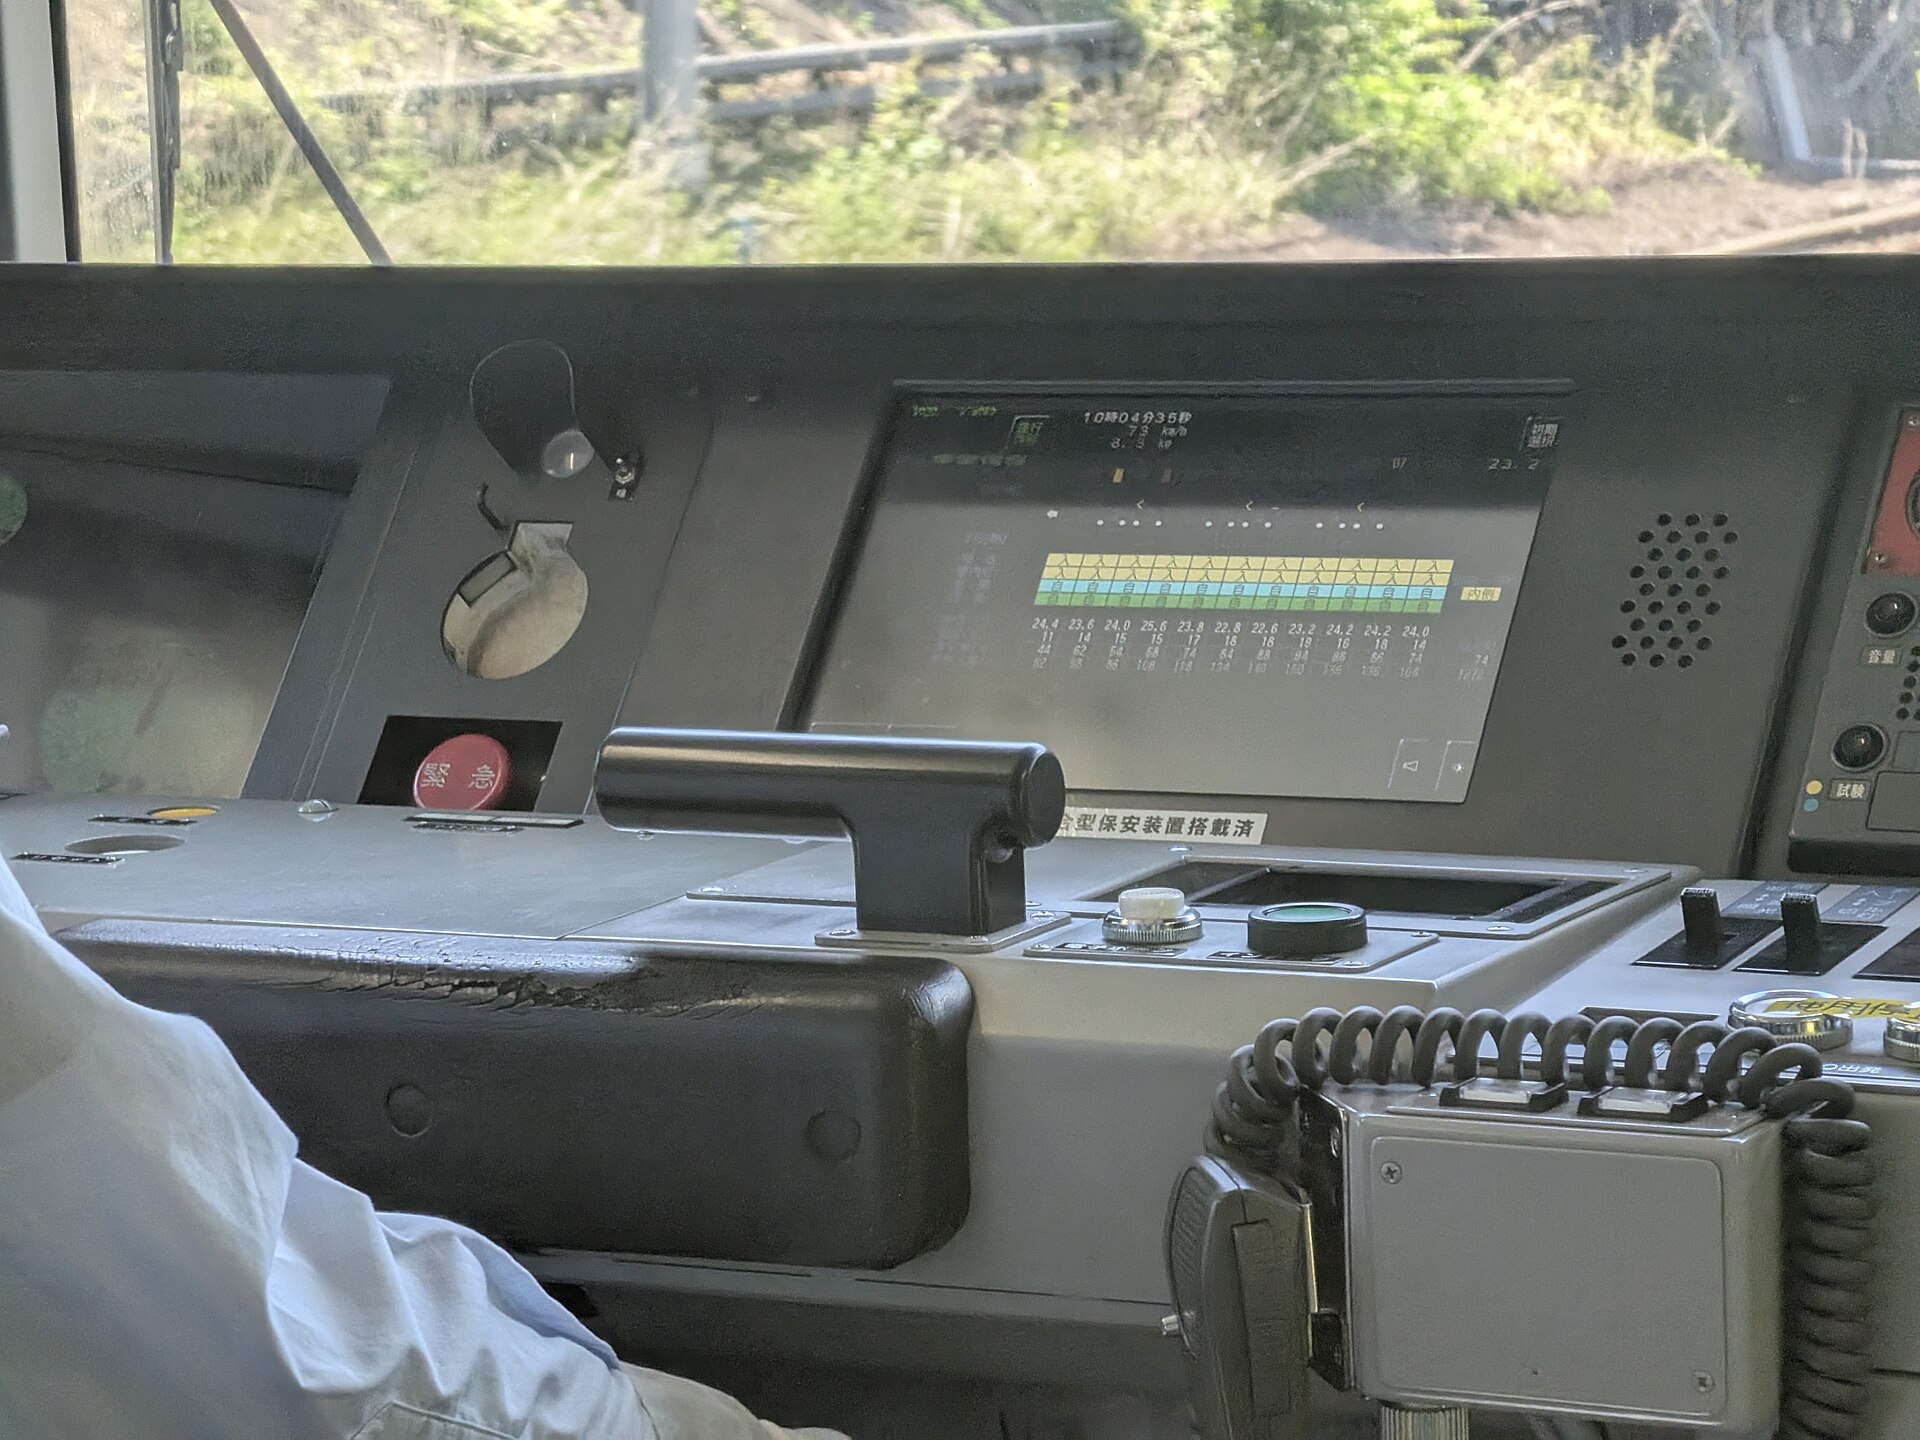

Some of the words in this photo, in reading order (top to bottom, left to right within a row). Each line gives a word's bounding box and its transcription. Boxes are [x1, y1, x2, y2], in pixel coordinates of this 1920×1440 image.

[1083, 411, 1192, 424] 10時04分35秒
[1032, 618, 1058, 630] 24.4
[1068, 618, 1094, 630] 23.6
[1104, 619, 1131, 632] 24.0
[1140, 620, 1167, 632] 25.6
[1177, 620, 1204, 632] 23.8
[1214, 622, 1241, 633] 22.8
[1251, 622, 1278, 634] 22.6
[1288, 624, 1316, 635] 23.2
[1326, 624, 1353, 636] 24.2
[1364, 626, 1392, 637] 24.2
[1402, 626, 1430, 638] 24.0
[1041, 632, 1054, 642] 11
[1078, 632, 1092, 643] 14
[1114, 632, 1128, 644] 15
[1151, 634, 1164, 645] 15
[1188, 634, 1200, 646] 17
[1224, 636, 1238, 647] 18
[1262, 636, 1275, 648] 18
[1300, 638, 1312, 648] 19
[1337, 638, 1350, 650] 16
[1375, 639, 1388, 650] 18
[1413, 640, 1426, 650] 14
[1868, 649, 1896, 665] 音量
[420, 763, 496, 789] 緊急
[1836, 783, 1866, 799] 試験
